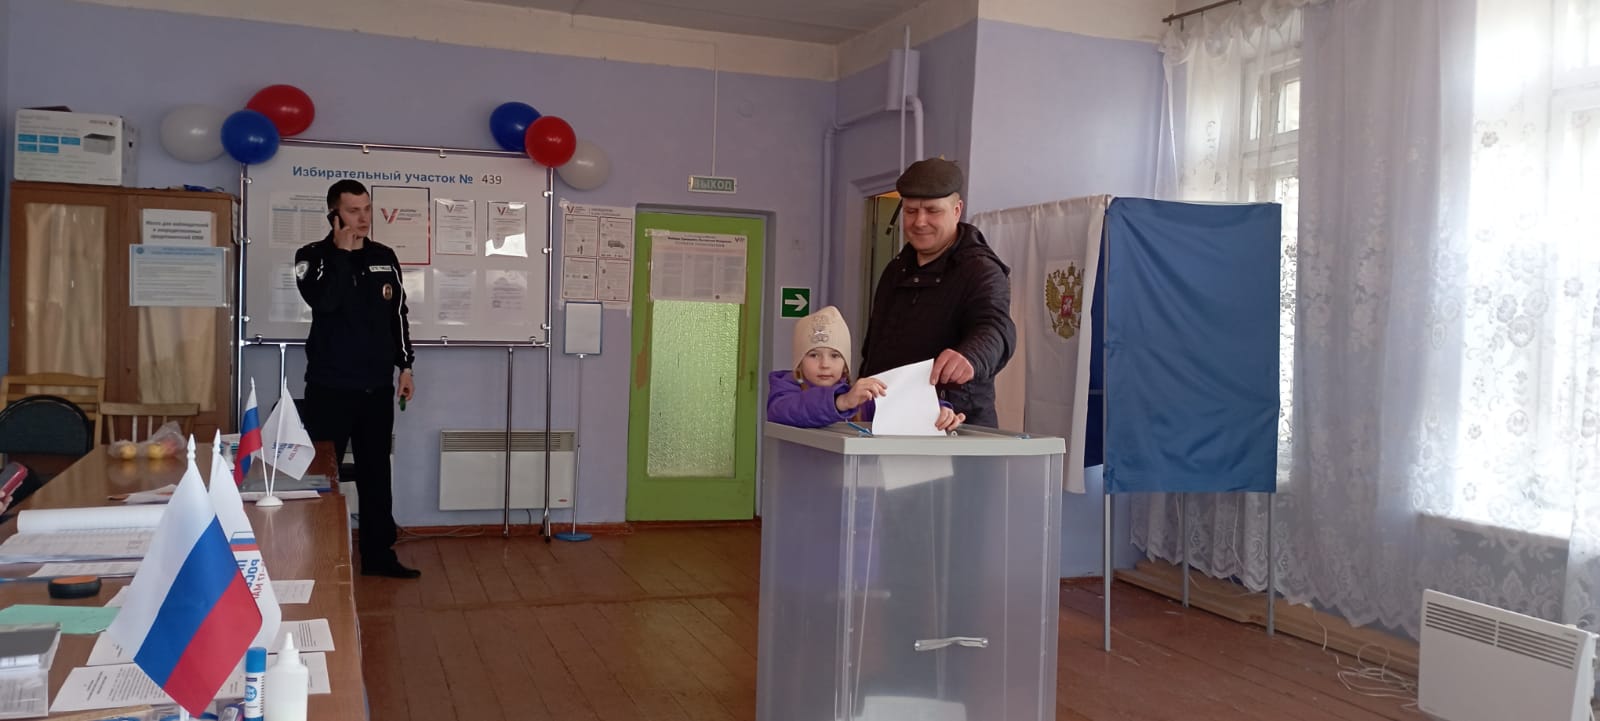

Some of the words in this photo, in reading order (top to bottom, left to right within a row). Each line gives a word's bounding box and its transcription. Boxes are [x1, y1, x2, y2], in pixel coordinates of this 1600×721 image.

[292, 166, 401, 181] Избирательный
[404, 172, 456, 184] участок
[459, 173, 474, 184] №
[481, 174, 502, 185] 439
[694, 178, 732, 190] ВЫХОД
